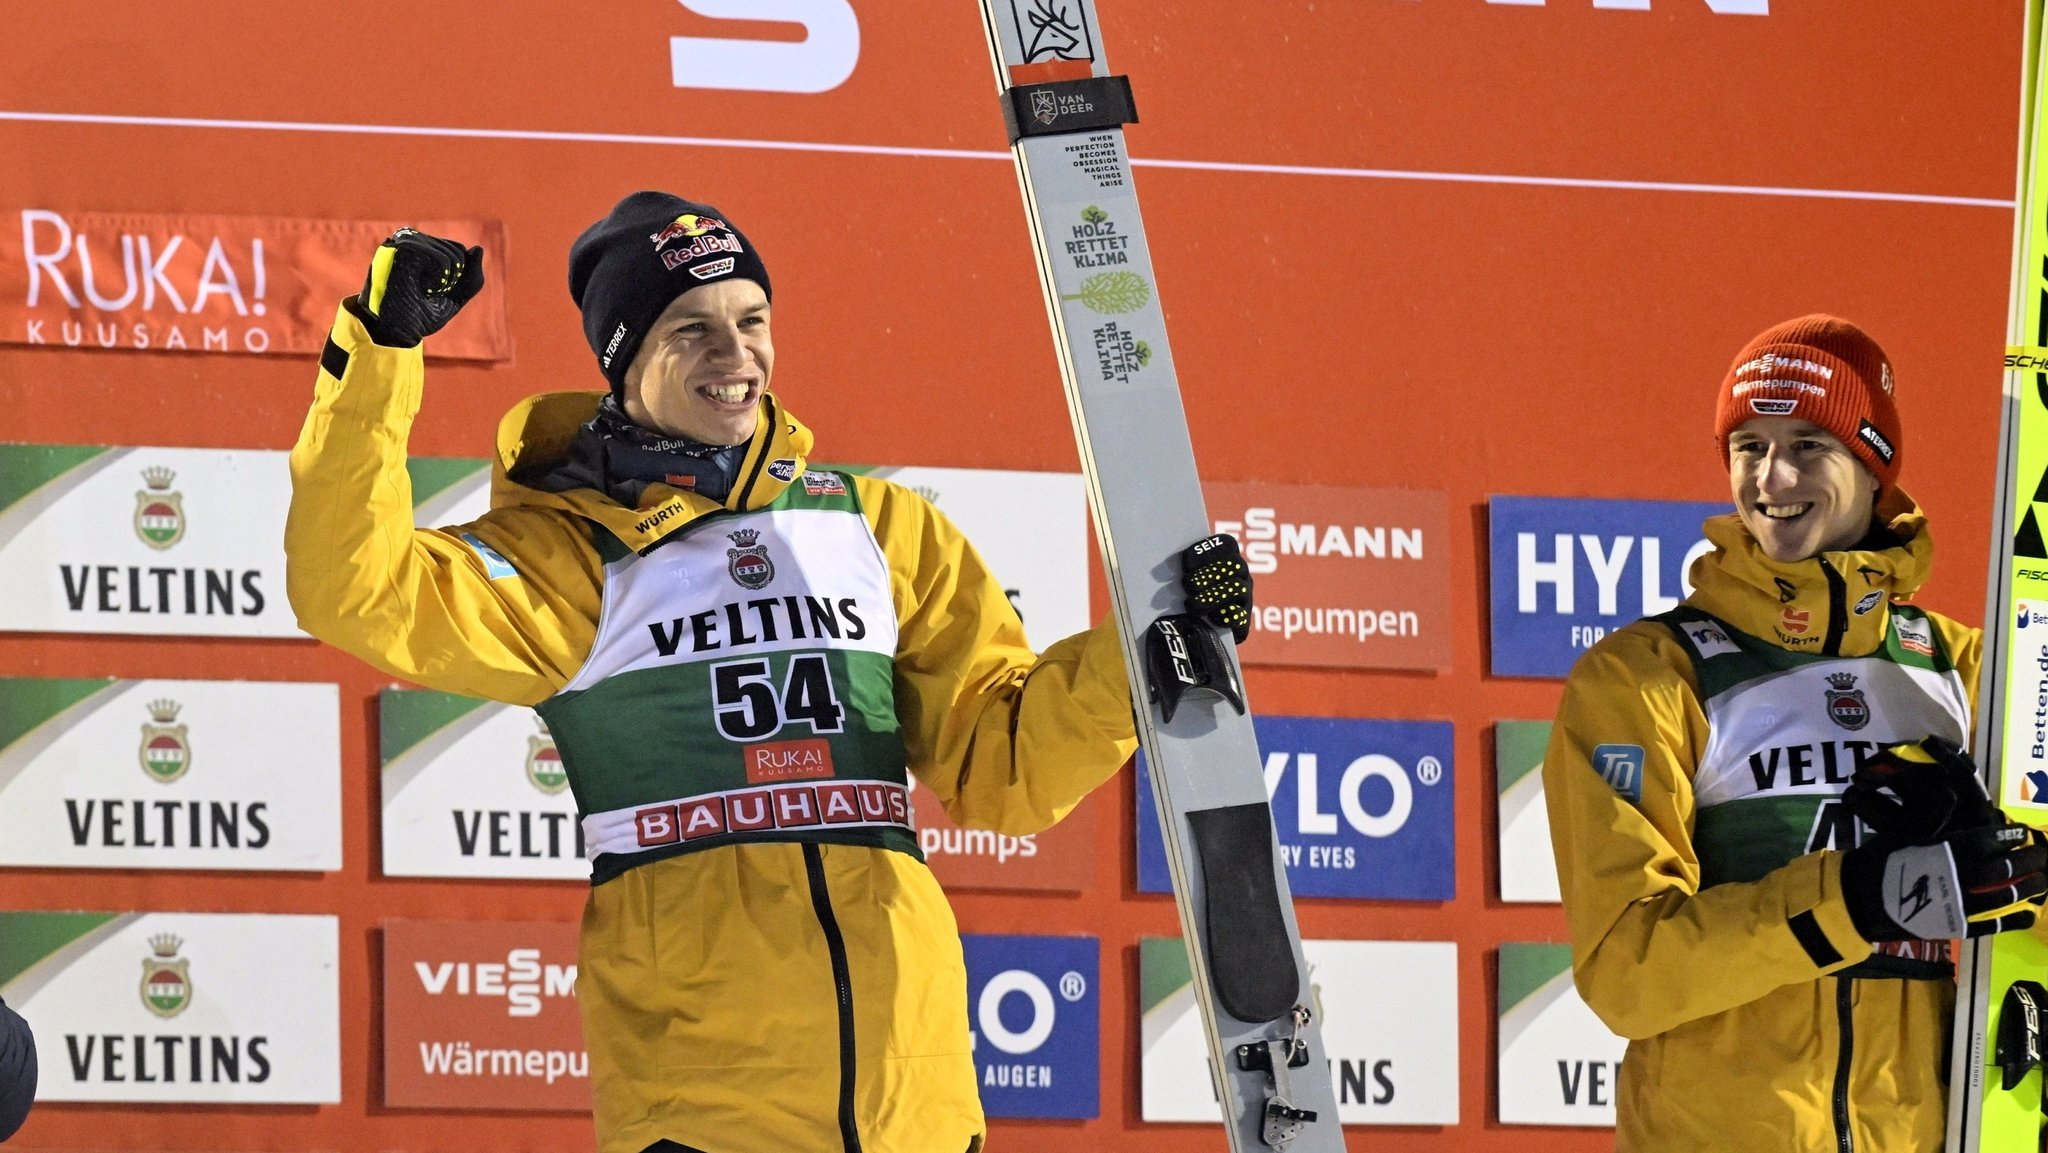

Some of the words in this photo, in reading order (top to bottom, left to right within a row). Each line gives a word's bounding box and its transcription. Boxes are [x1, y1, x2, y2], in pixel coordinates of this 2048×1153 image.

[1057, 94, 1085, 105] VAN
[1060, 103, 1094, 115] DEER
[1065, 142, 1115, 152] PERFECTION
[1079, 150, 1117, 159] BECOMES
[1073, 158, 1118, 167] OBSESSION
[1084, 165, 1120, 173] MAGICAL
[1092, 172, 1122, 181] THINGS
[1100, 180, 1123, 188] ARISE
[1072, 222, 1116, 239] HOLZ
[661, 238, 708, 270] Red
[702, 233, 743, 253] Bull
[1065, 236, 1128, 254] RETTET
[21, 209, 267, 317] RUKA!
[1073, 251, 1128, 268] KLIMA
[27, 320, 270, 353] KUUSAMO
[605, 321, 628, 358] TERREX
[1093, 328, 1114, 381] KLIMA
[1105, 321, 1128, 384] RETTET
[1120, 330, 1139, 372] HOLZ
[1736, 353, 1833, 380] VIESSMANN
[1732, 378, 1826, 397] Wärmepumpen
[635, 500, 685, 535] WÜRTH
[1194, 536, 1223, 555] SEIZ
[59, 564, 265, 617] VELTINS
[648, 596, 866, 657] VELTINS
[1160, 620, 1196, 684] FES
[709, 652, 845, 742] 54
[756, 749, 823, 770] RUKA!
[758, 765, 824, 777] KUUSAMO
[1749, 739, 1888, 791] VELT
[64, 798, 270, 849] VELTINS
[641, 788, 906, 839] BAUHAUS
[921, 827, 1037, 864] pumps
[1996, 827, 2025, 841] SEIZ
[1309, 846, 1355, 869] EYES
[2012, 985, 2041, 1061] FES
[65, 1034, 271, 1083] VELTINS
[984, 1064, 1051, 1088] AUGEN
